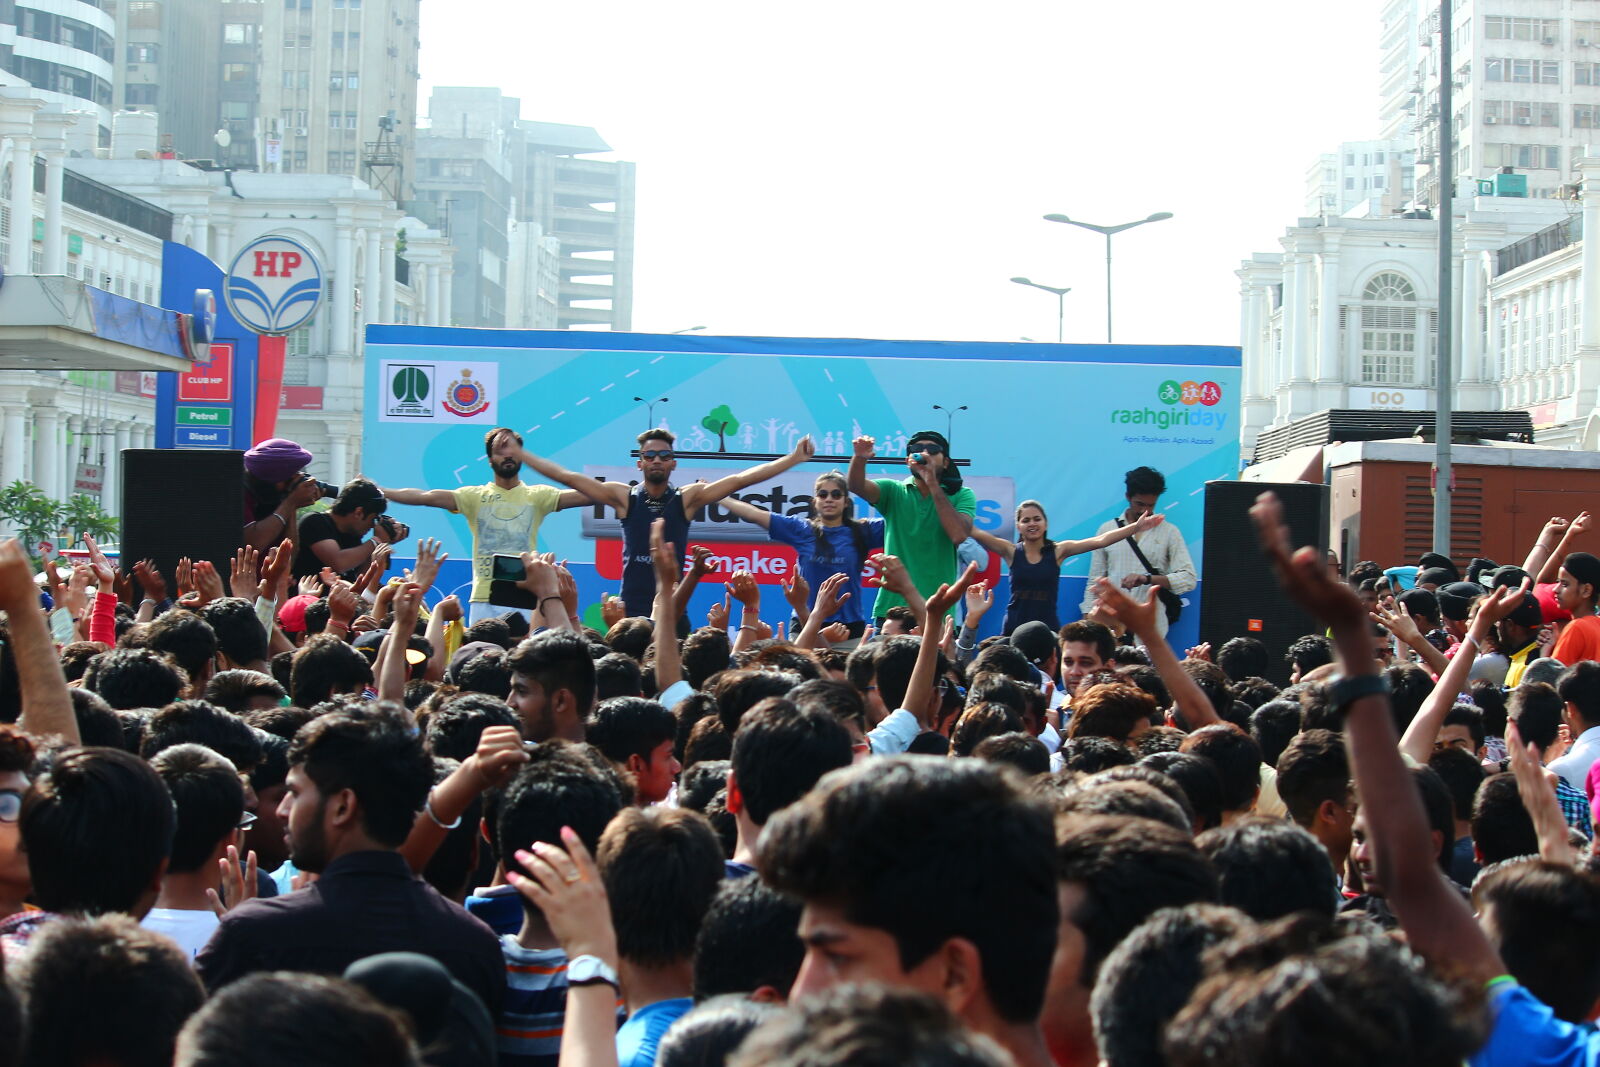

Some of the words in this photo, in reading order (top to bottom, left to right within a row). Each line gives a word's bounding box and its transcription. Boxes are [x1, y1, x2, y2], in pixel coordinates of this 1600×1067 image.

[253, 251, 302, 277] HP
[189, 412, 218, 420] Petrol
[189, 432, 218, 441] Diesel
